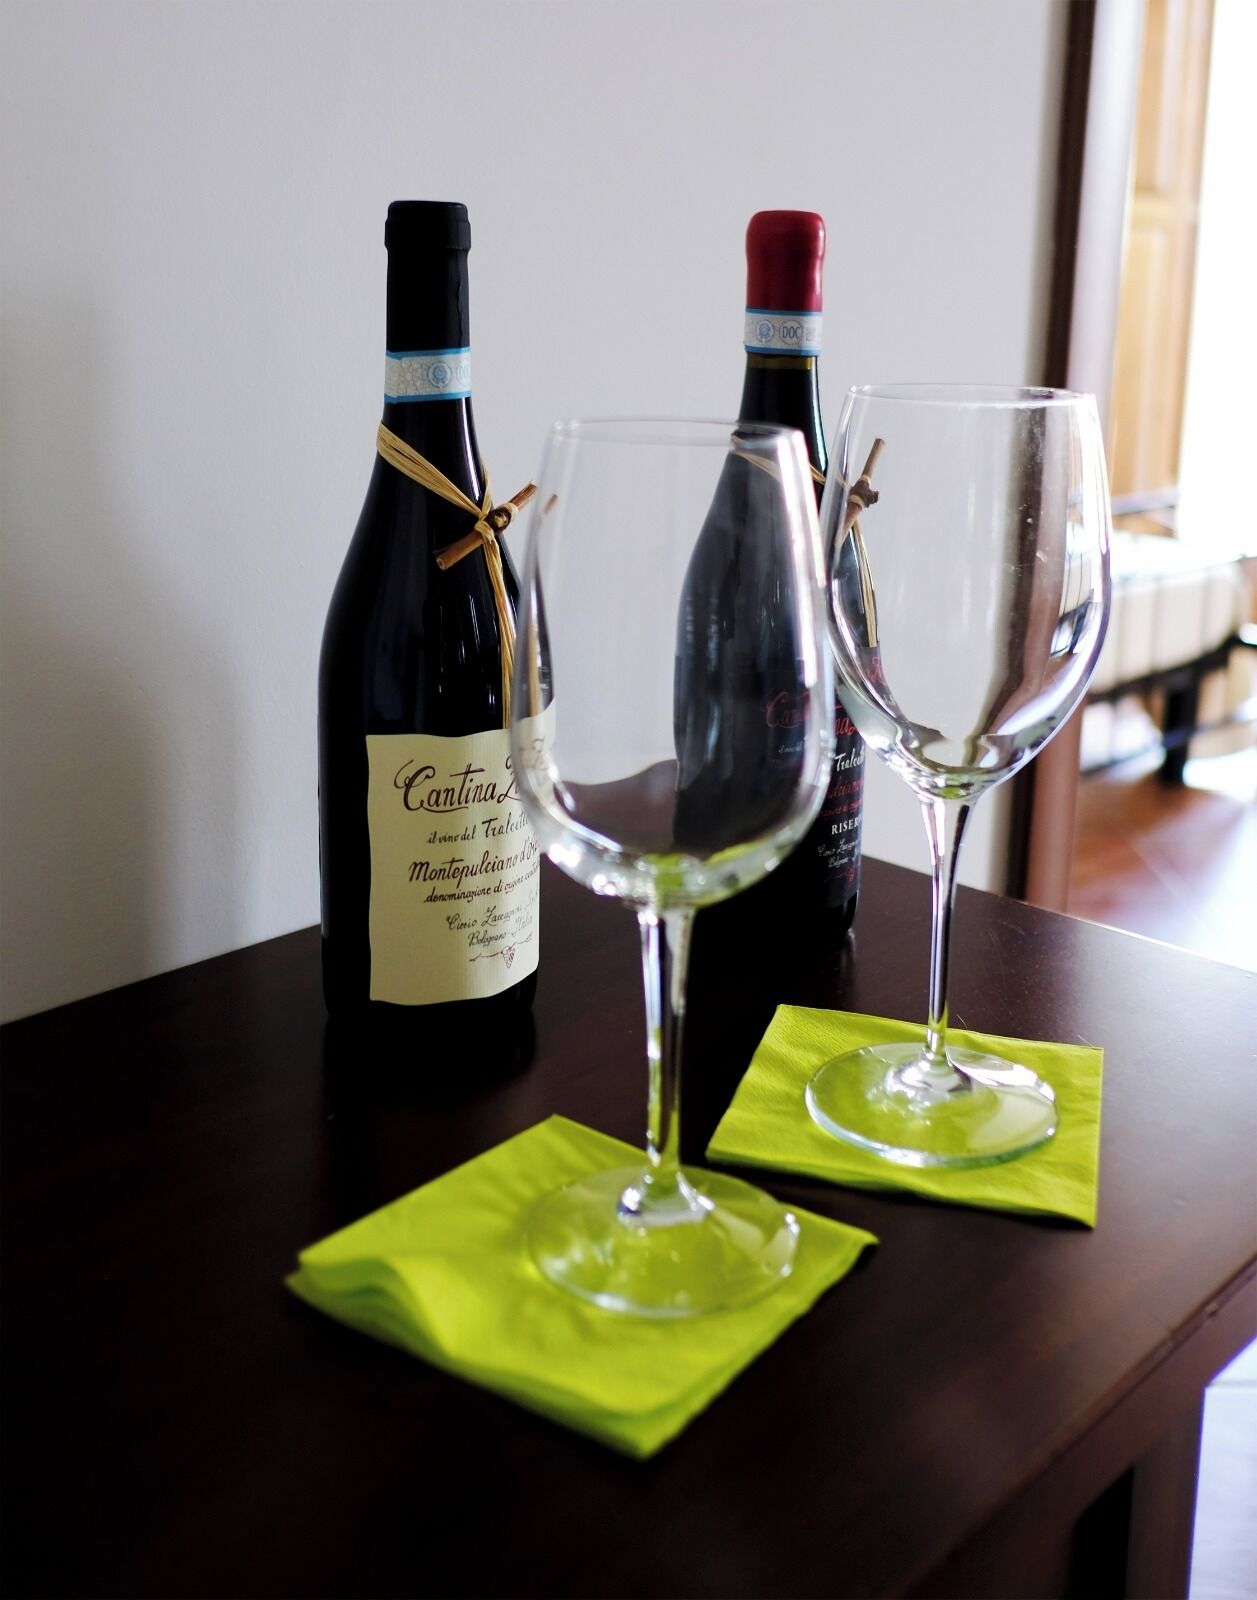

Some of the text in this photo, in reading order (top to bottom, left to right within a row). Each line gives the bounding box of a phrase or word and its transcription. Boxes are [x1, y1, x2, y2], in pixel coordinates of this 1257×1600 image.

[782, 326, 801, 340] DOC
[394, 760, 498, 813] Cantina
[427, 809, 529, 844] il vino del Tralcett
[409, 850, 518, 889] Montepulciano
[424, 886, 492, 903] denominazione
[493, 879, 503, 893] di
